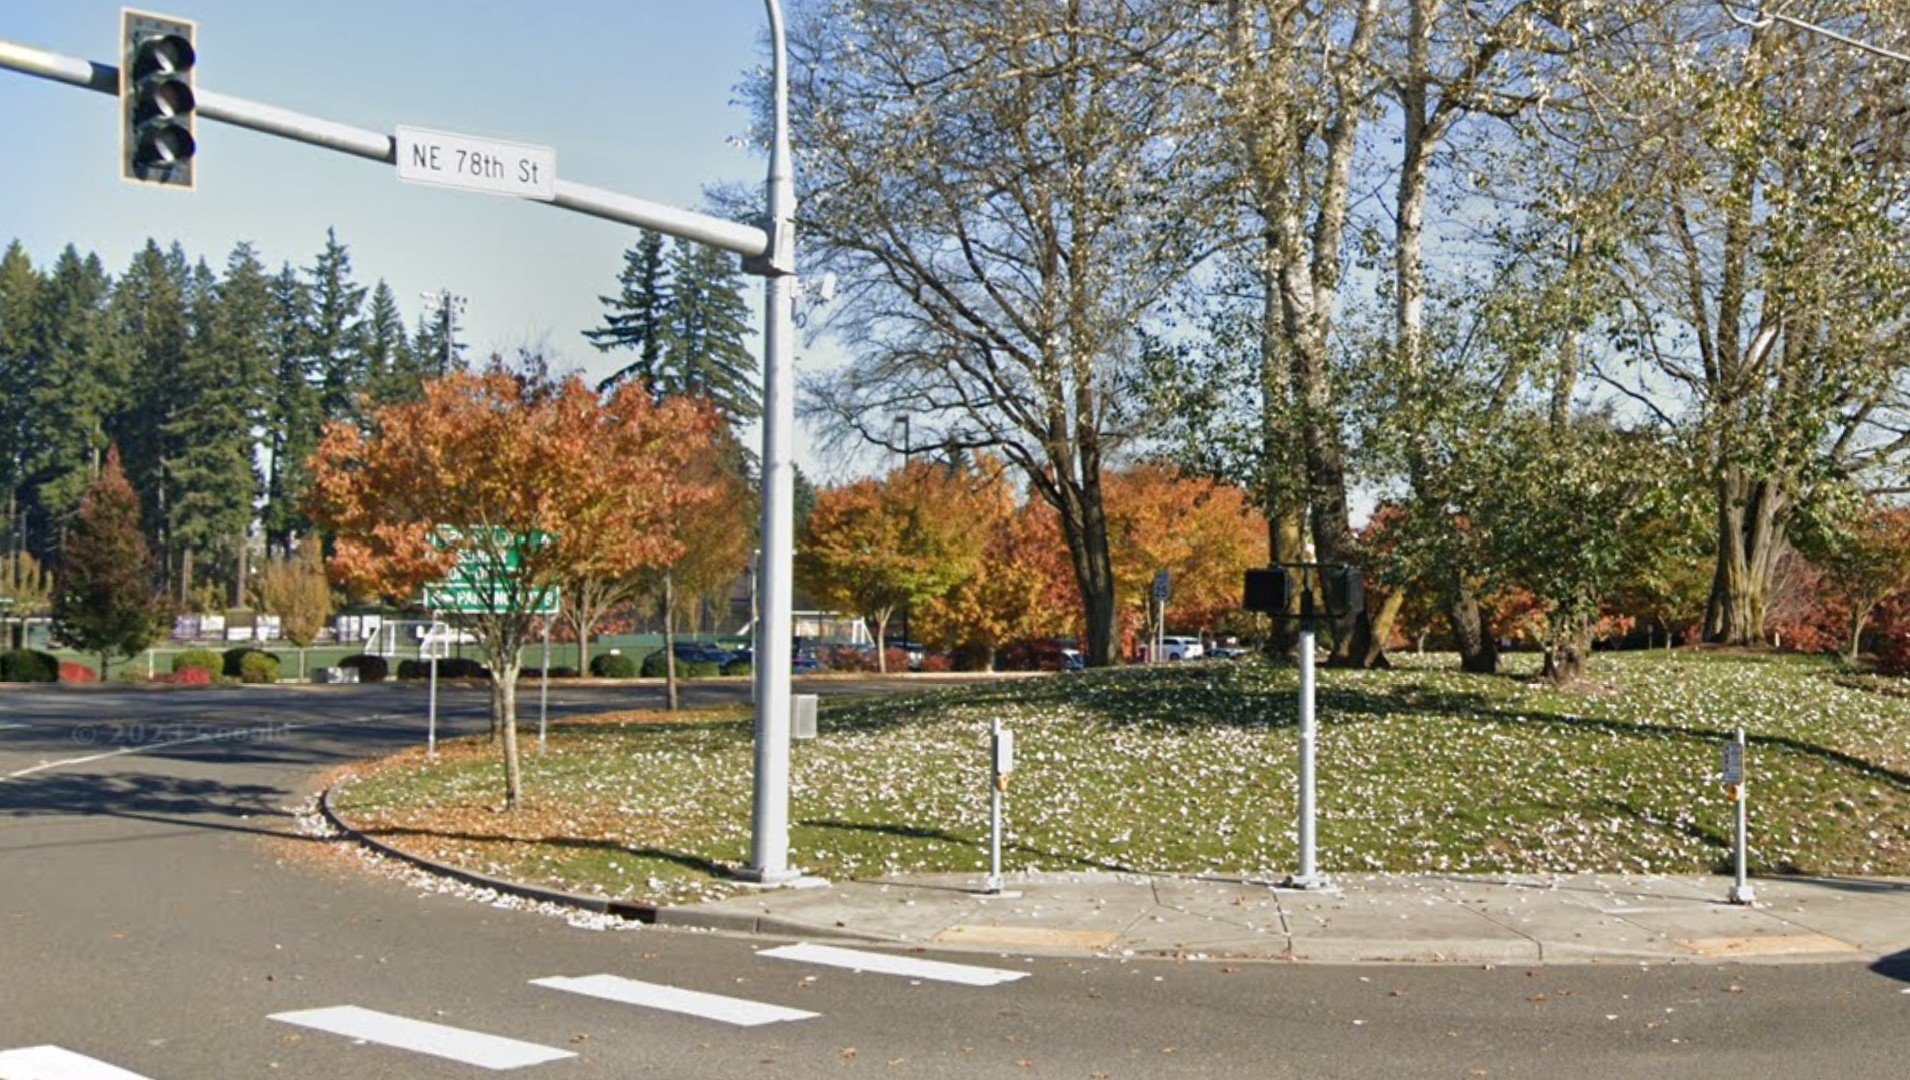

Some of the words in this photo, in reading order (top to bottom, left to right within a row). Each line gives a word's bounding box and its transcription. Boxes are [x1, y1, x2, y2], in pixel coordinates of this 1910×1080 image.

[412, 142, 442, 171] NE
[455, 149, 504, 180] 78th
[518, 158, 539, 184] St
